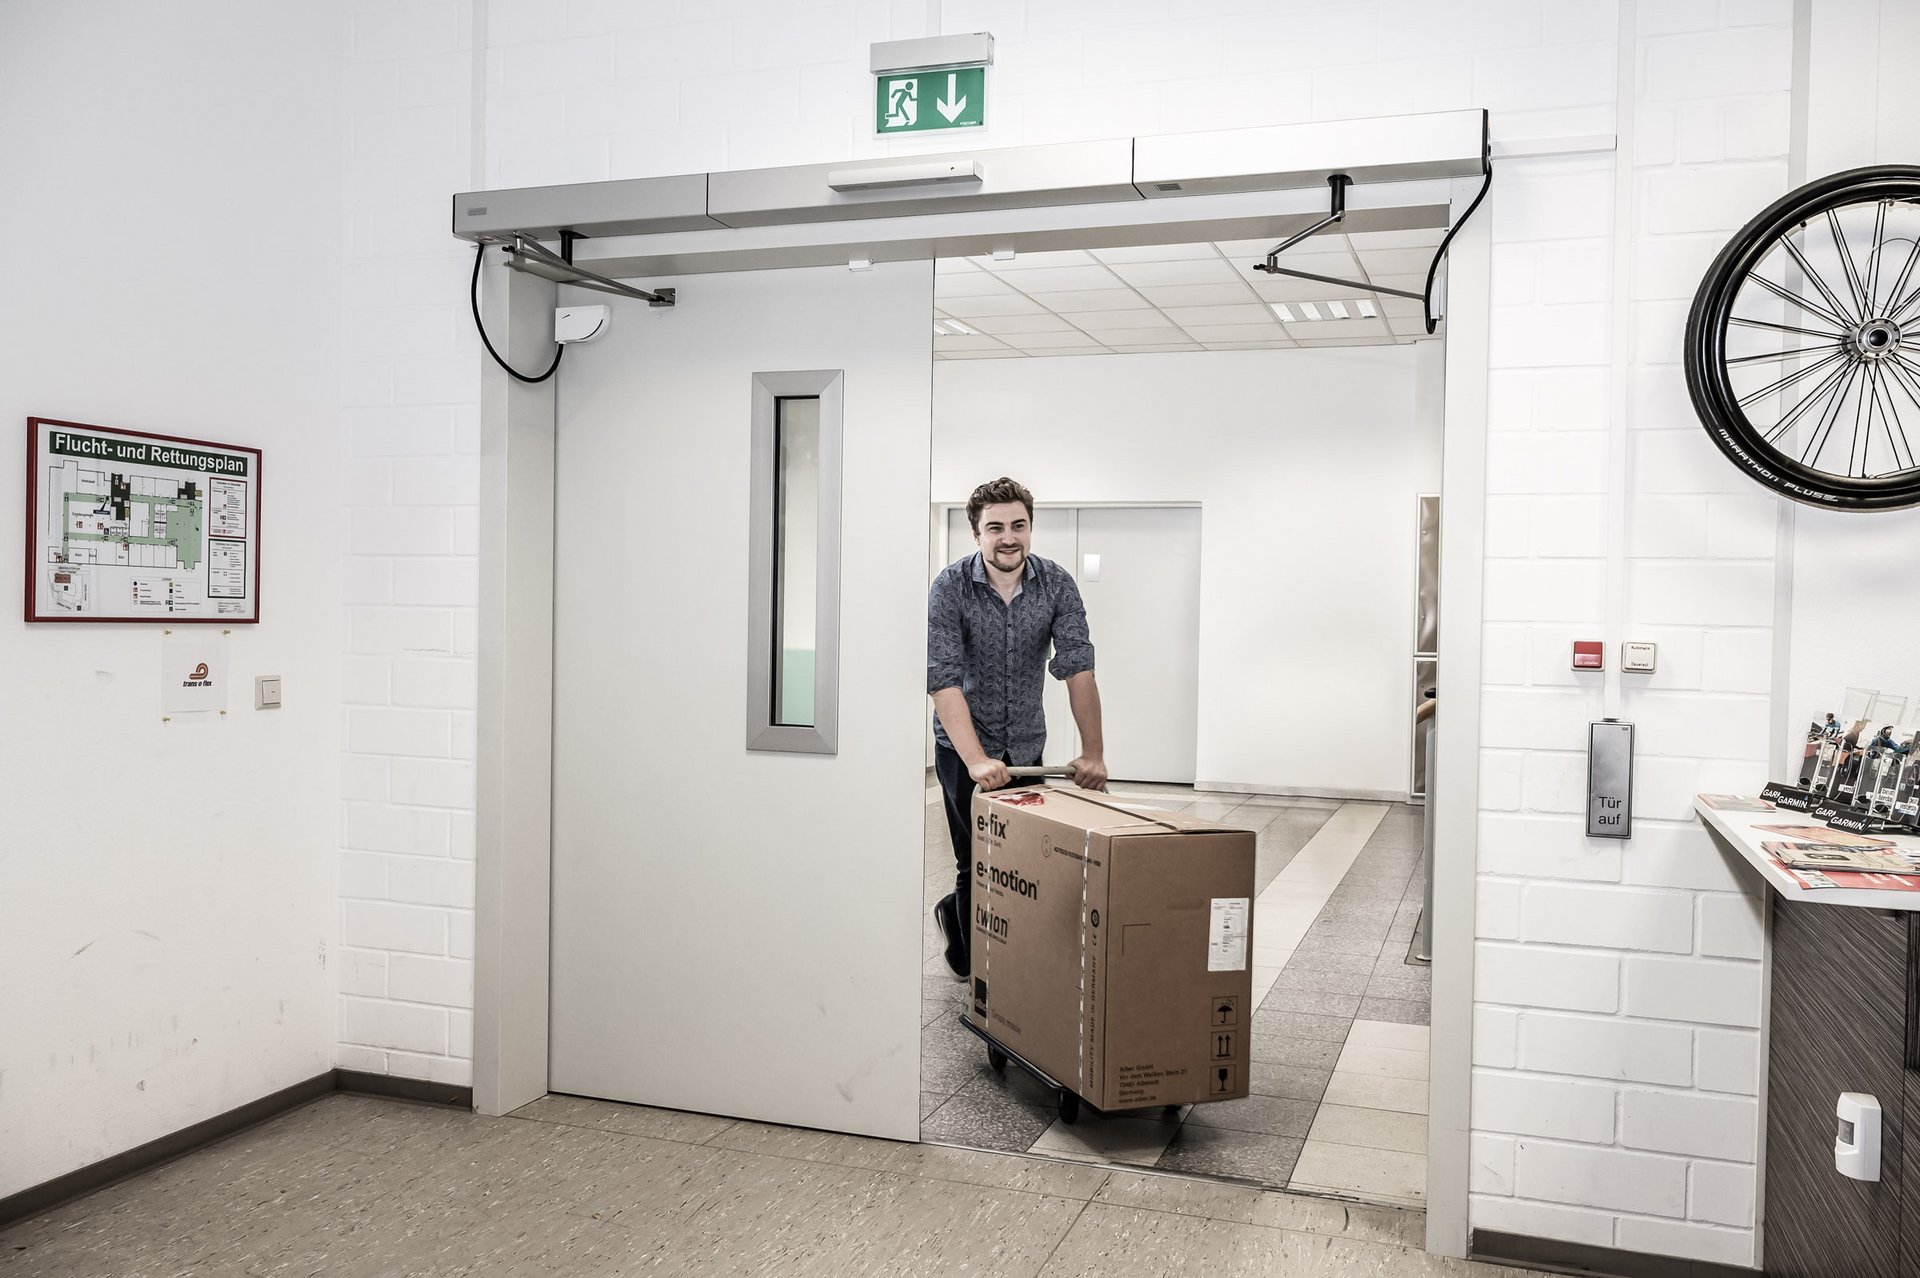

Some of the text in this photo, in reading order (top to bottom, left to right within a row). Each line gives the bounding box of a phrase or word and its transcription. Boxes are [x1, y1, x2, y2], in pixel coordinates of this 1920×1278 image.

[55, 433, 244, 474] Flucht- und Rettungsplan
[1718, 428, 1779, 482] MARATHON
[1598, 796, 1622, 809] Tür
[1777, 796, 1808, 809] GARMIN
[1598, 813, 1622, 826] auf
[1830, 816, 1865, 831] GARMIN
